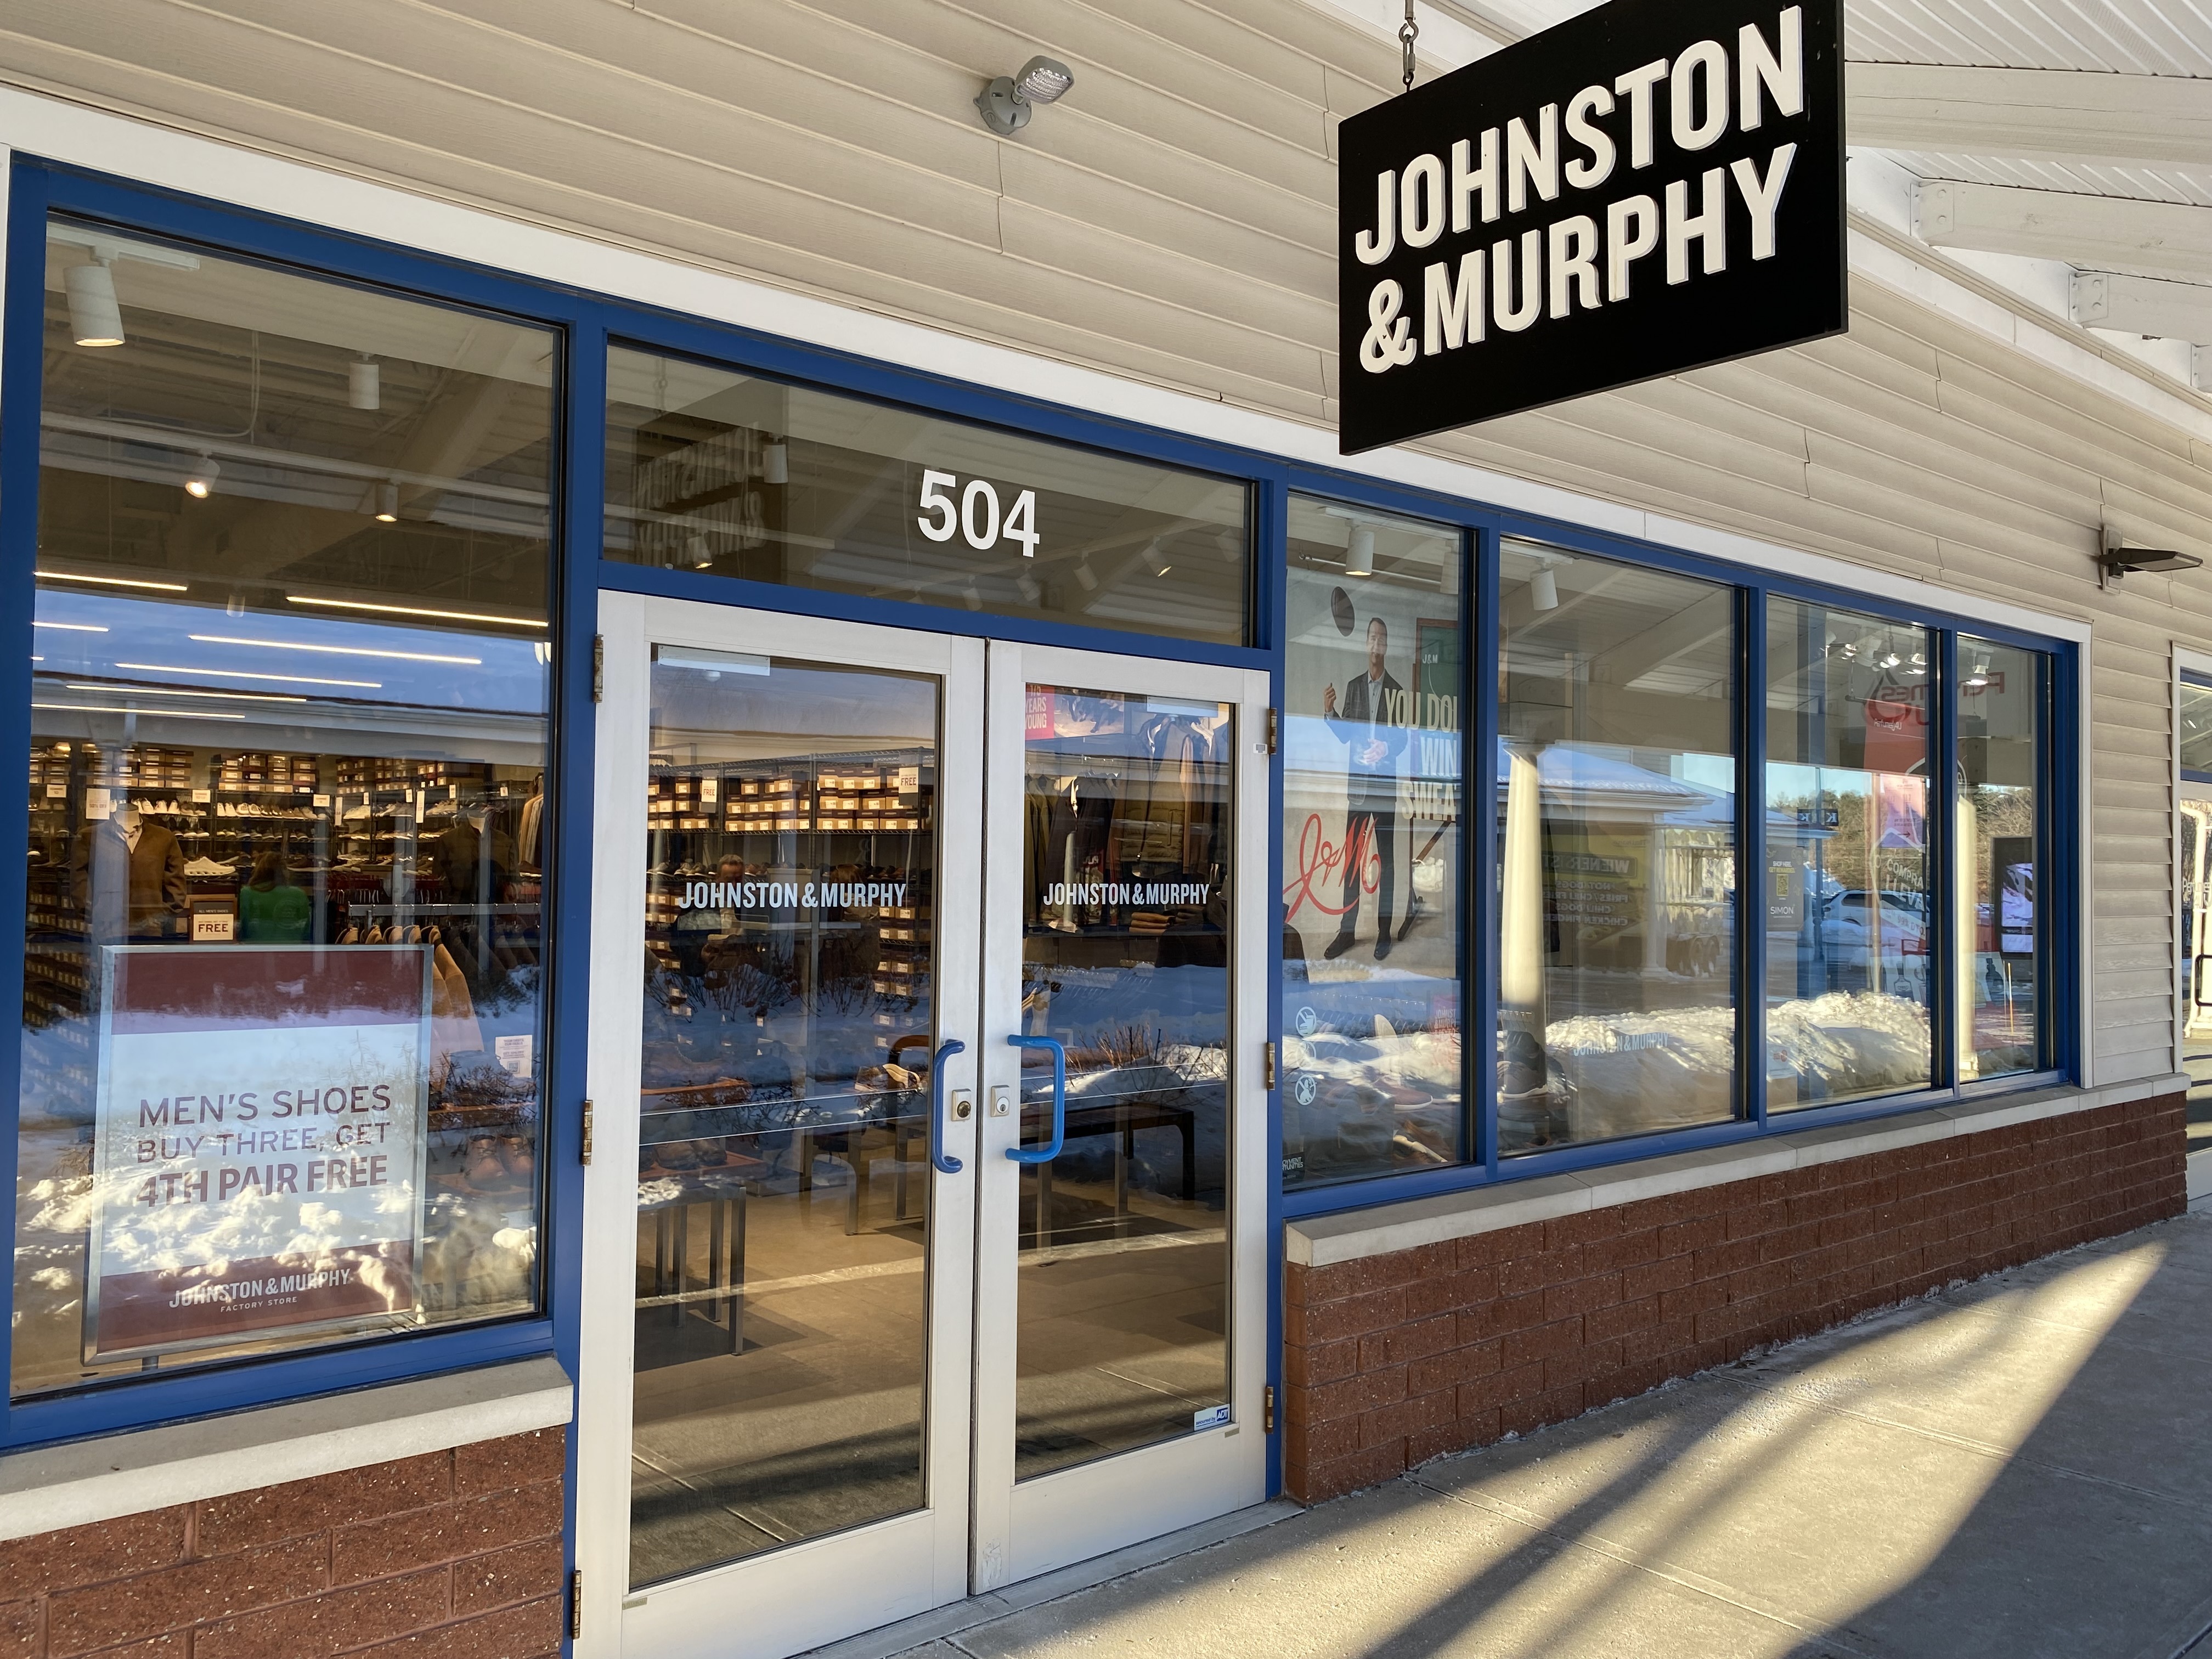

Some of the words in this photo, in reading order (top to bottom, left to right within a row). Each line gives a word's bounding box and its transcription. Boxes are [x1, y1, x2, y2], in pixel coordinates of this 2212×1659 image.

[1355, 5, 1804, 266] JOHNSTON
[918, 469, 1040, 557] 504
[1026, 697, 1047, 713] YEARS
[1385, 688, 1421, 730] YOU
[901, 777, 917, 786] FREE
[1401, 780, 1457, 821] SWEA
[679, 882, 798, 909] JOHNSTON
[821, 883, 906, 908] MURPHY
[1043, 883, 1128, 905] JOHNSTON
[1146, 883, 1210, 905] MURPHY
[1770, 906, 1794, 915] SIMON
[198, 923, 229, 933] FREE
[1632, 1031, 1668, 1051] MURPHY
[139, 1093, 258, 1128] MEN'S
[272, 1084, 391, 1118] SHOES
[137, 1135, 205, 1163] BUY
[216, 1127, 324, 1156] THREE,
[336, 1122, 390, 1146] GET
[137, 1170, 208, 1207] 4TH
[219, 1163, 298, 1200] PAIR
[307, 1155, 387, 1192] FREE
[169, 1280, 262, 1308] JOHNSTON
[281, 1268, 351, 1294] MURPHY
[221, 1300, 263, 1312] FACTORY
[268, 1296, 297, 1306] STORE
[1218, 1409, 1228, 1419] ADT
